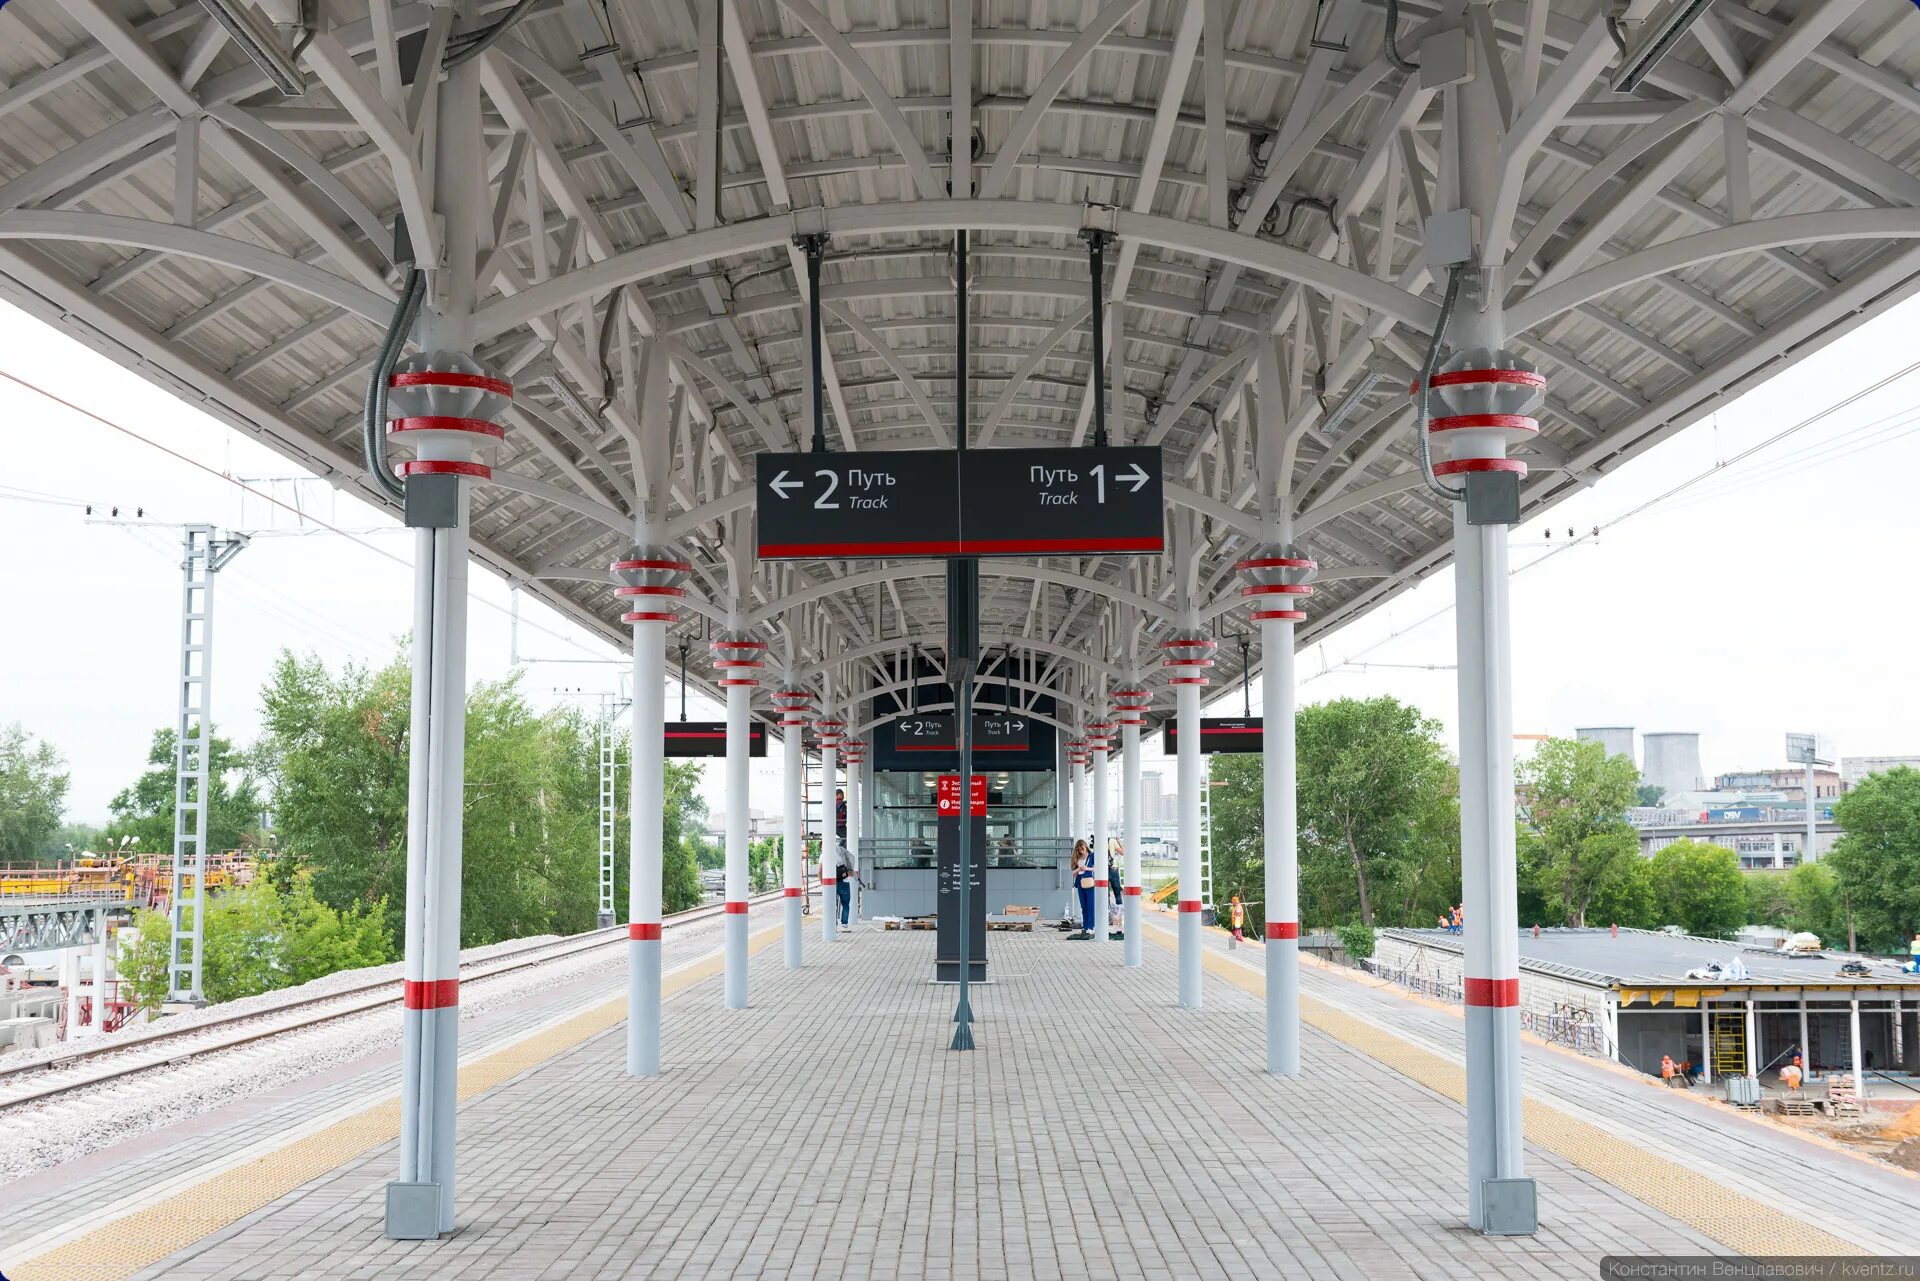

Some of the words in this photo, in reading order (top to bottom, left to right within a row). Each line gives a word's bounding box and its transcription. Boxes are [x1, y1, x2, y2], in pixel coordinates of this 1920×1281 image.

[814, 469, 840, 509] 2
[848, 469, 896, 490] Путь
[1030, 465, 1078, 487] Путь
[1089, 464, 1105, 504] 1
[849, 495, 888, 509] Track
[1039, 491, 1078, 505] Track
[914, 721, 924, 736] 2
[925, 721, 942, 730] Путь
[984, 721, 1001, 729] Путь
[1003, 720, 1010, 735] 1
[1724, 811, 1741, 820] DSV
